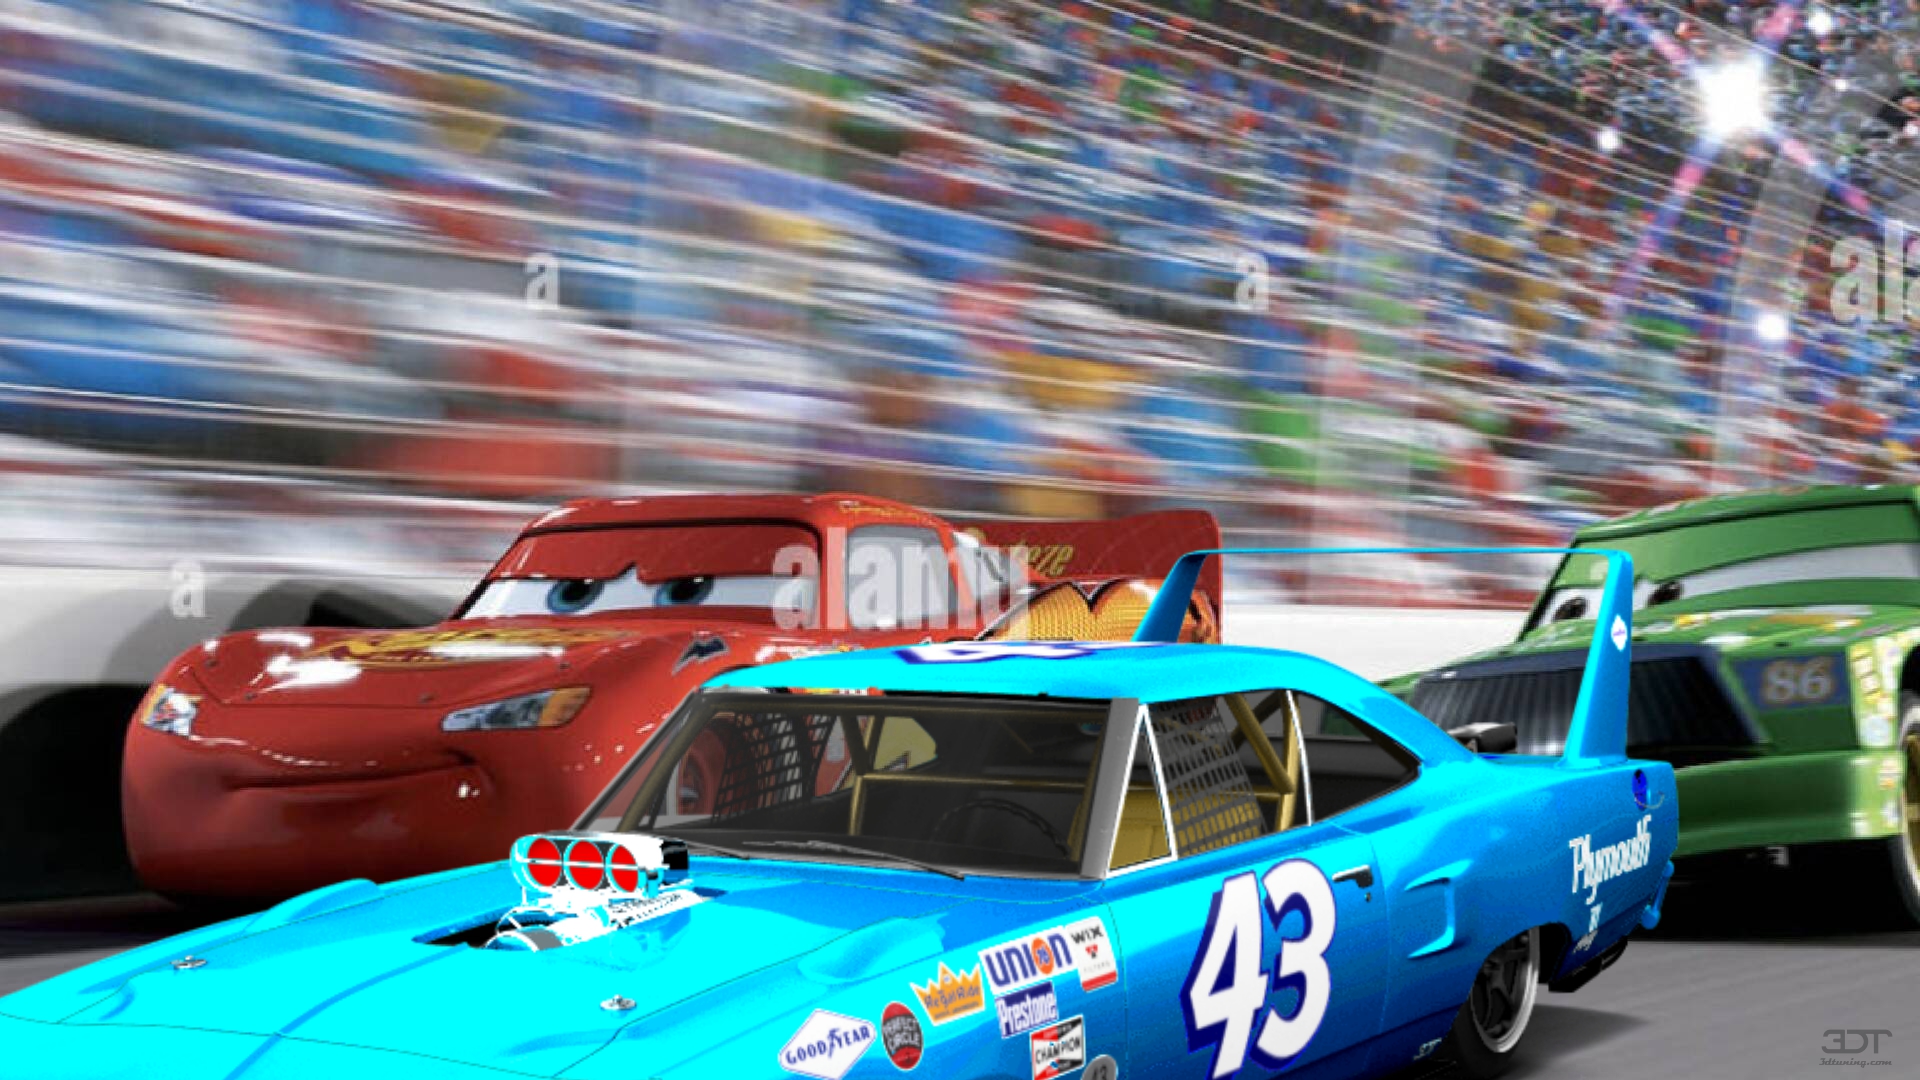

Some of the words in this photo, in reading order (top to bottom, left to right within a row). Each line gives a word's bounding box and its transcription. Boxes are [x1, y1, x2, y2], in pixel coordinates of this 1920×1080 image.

[1762, 656, 1838, 709] 86
[1569, 814, 1652, 905] Plymouth
[1071, 926, 1103, 944] WIX
[1179, 858, 1337, 1079] 43
[997, 993, 1057, 1038] Prestone
